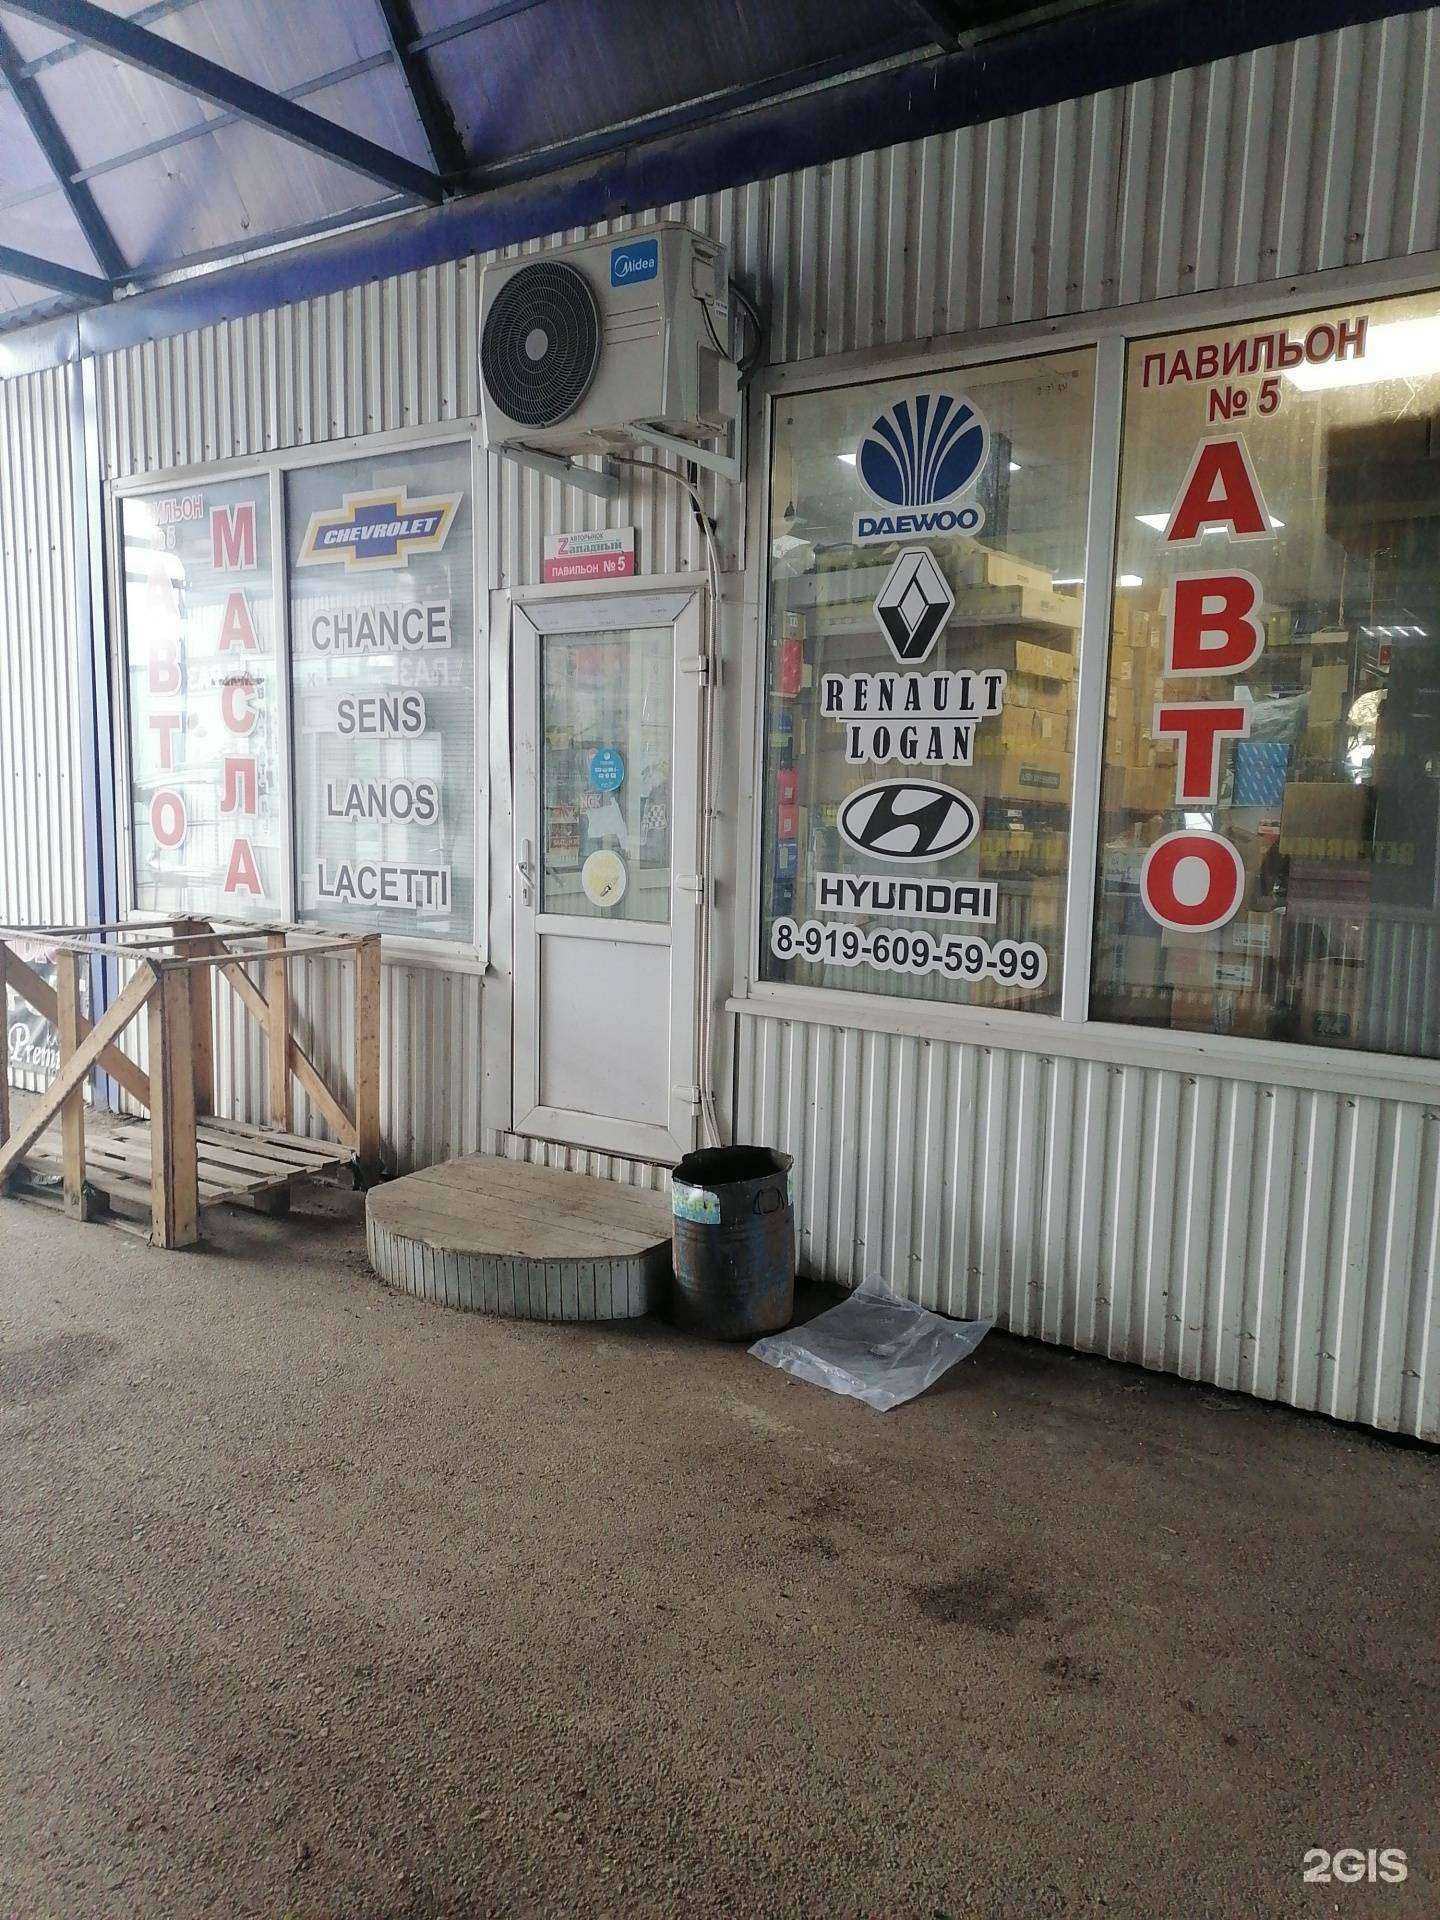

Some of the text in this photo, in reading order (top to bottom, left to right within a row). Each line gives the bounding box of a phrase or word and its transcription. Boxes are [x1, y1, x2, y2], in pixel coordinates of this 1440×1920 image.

[614, 254, 655, 277] Midea
[1142, 317, 1368, 389] ПАВИЛЬОН
[1208, 378, 1280, 421] № 5
[323, 516, 439, 545] CHEVROLET
[858, 507, 979, 538] DAEWOO
[551, 556, 627, 577] ПАВИЛЬОН № 5
[312, 606, 448, 651] CHANCE
[825, 675, 1003, 712] RENAULT
[1146, 441, 1268, 927] АВТО
[337, 695, 422, 734] SENS
[849, 725, 972, 761] LOGAN
[327, 782, 435, 820] LANOS
[318, 864, 448, 906] LACETTI
[820, 878, 992, 918] HYUNDAI
[777, 924, 1042, 983] 8-919-609-59-99
